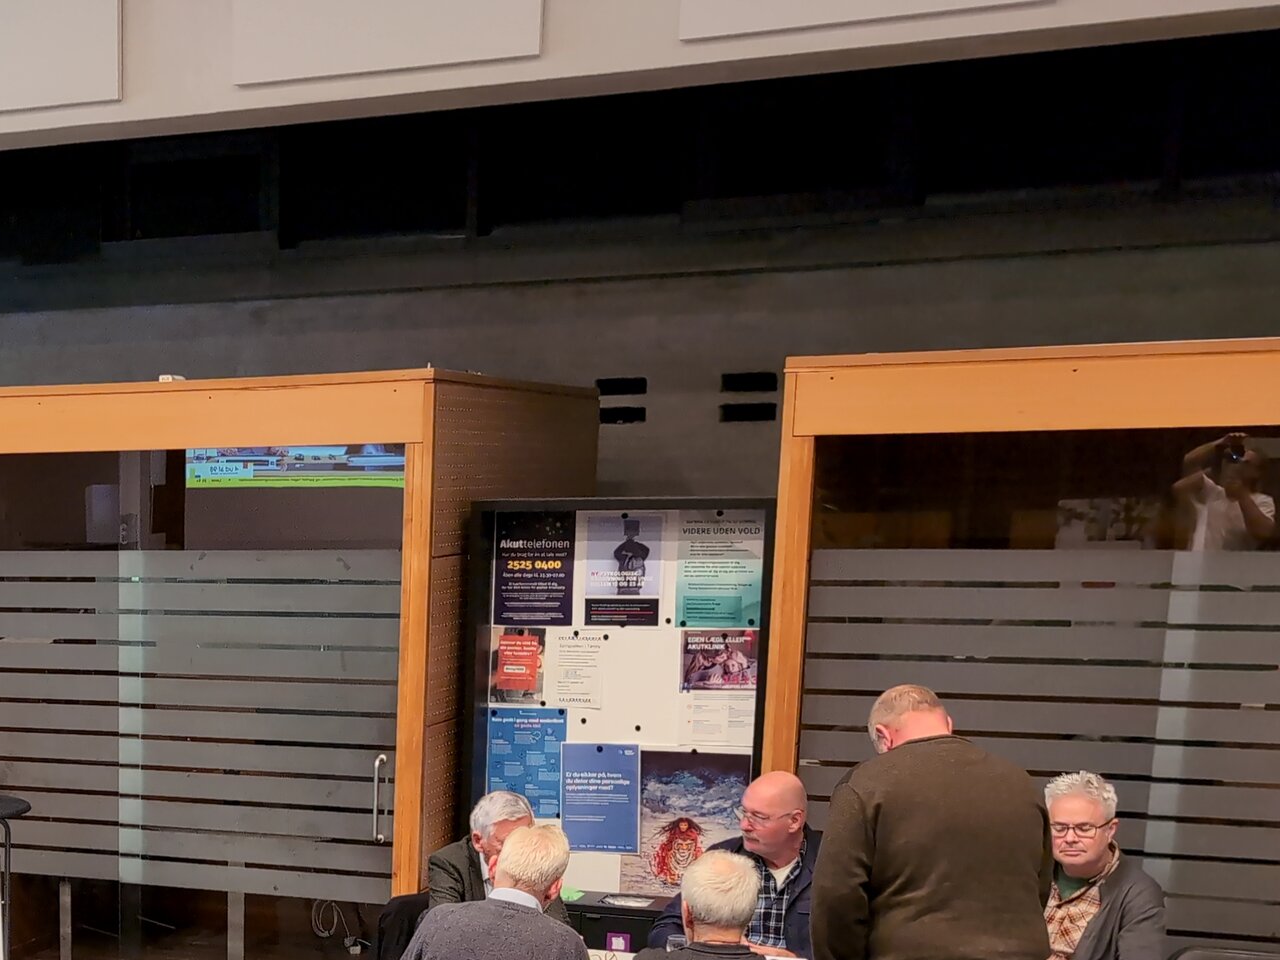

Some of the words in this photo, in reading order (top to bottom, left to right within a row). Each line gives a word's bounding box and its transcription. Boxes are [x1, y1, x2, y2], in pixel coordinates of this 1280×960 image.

[500, 539, 570, 548] Akuttelefonen
[507, 561, 532, 570] 2525
[534, 560, 561, 570] 0400
